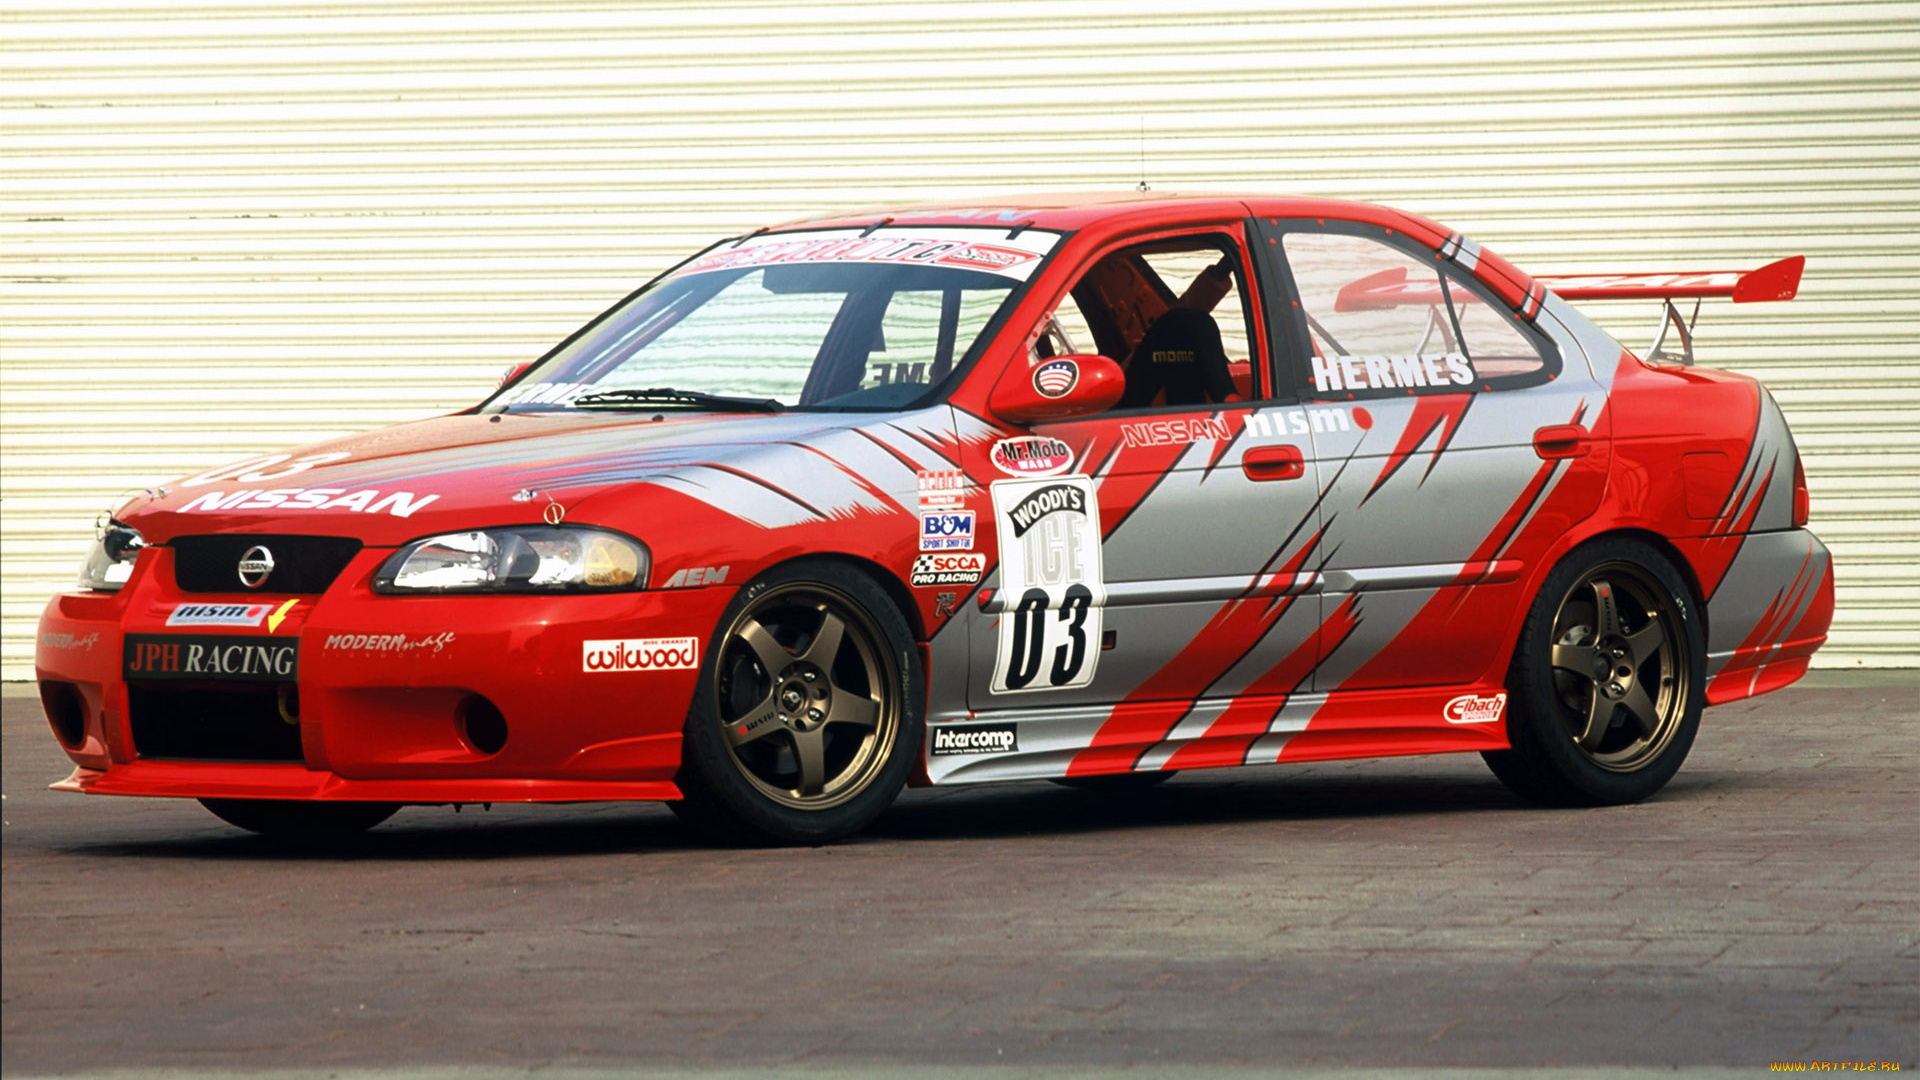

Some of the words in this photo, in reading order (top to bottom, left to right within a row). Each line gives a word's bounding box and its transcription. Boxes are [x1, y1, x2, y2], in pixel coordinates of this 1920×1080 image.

[1152, 350, 1195, 363] momo
[1311, 353, 1474, 391] HERMES
[1120, 419, 1232, 447] NISSAN
[1017, 459, 1053, 470] WASH
[176, 488, 440, 517] NISSAN
[1013, 487, 1082, 529] WOODY'S
[1023, 512, 1084, 586] ICE
[241, 562, 267, 570] NISSAN
[934, 556, 980, 571] SCCA
[662, 566, 729, 588] AEM
[912, 574, 936, 584] PRO
[937, 572, 979, 583] RACING
[1005, 583, 1093, 690] 03
[130, 643, 181, 672] JPH
[184, 644, 296, 675] RACING
[587, 638, 696, 669] wilwood
[1447, 697, 1502, 720] Eibach
[935, 729, 1014, 751] Intercomp
